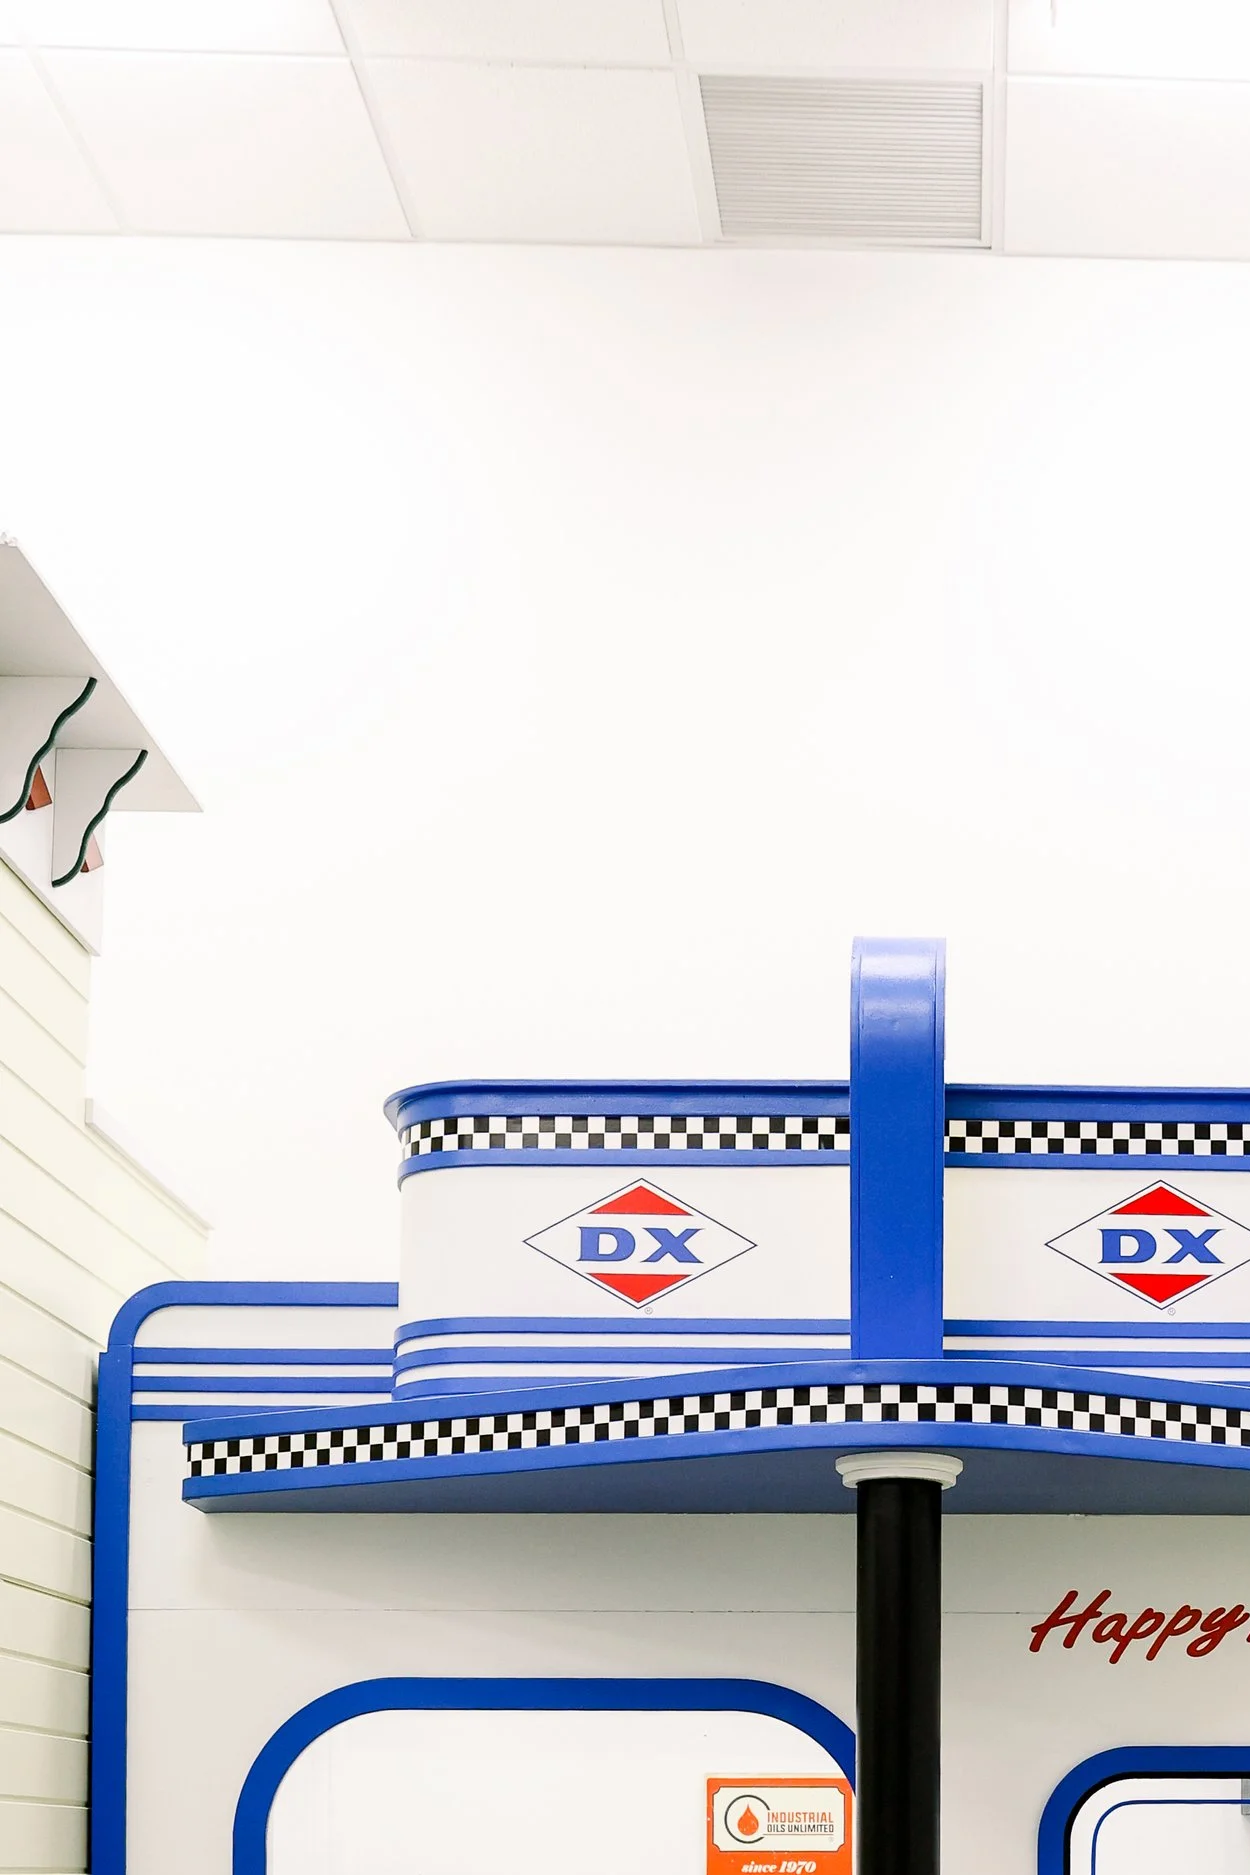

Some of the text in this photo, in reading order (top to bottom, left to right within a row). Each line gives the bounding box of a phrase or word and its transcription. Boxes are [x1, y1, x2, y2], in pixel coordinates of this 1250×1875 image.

[577, 1226, 706, 1264] DX
[1098, 1227, 1225, 1265] DX
[1029, 1589, 1250, 1665] Happy
[767, 1811, 834, 1823] INDUSTRIAL
[767, 1823, 834, 1833] OILS UNLIMITED
[741, 1860, 817, 1875] since 1970
